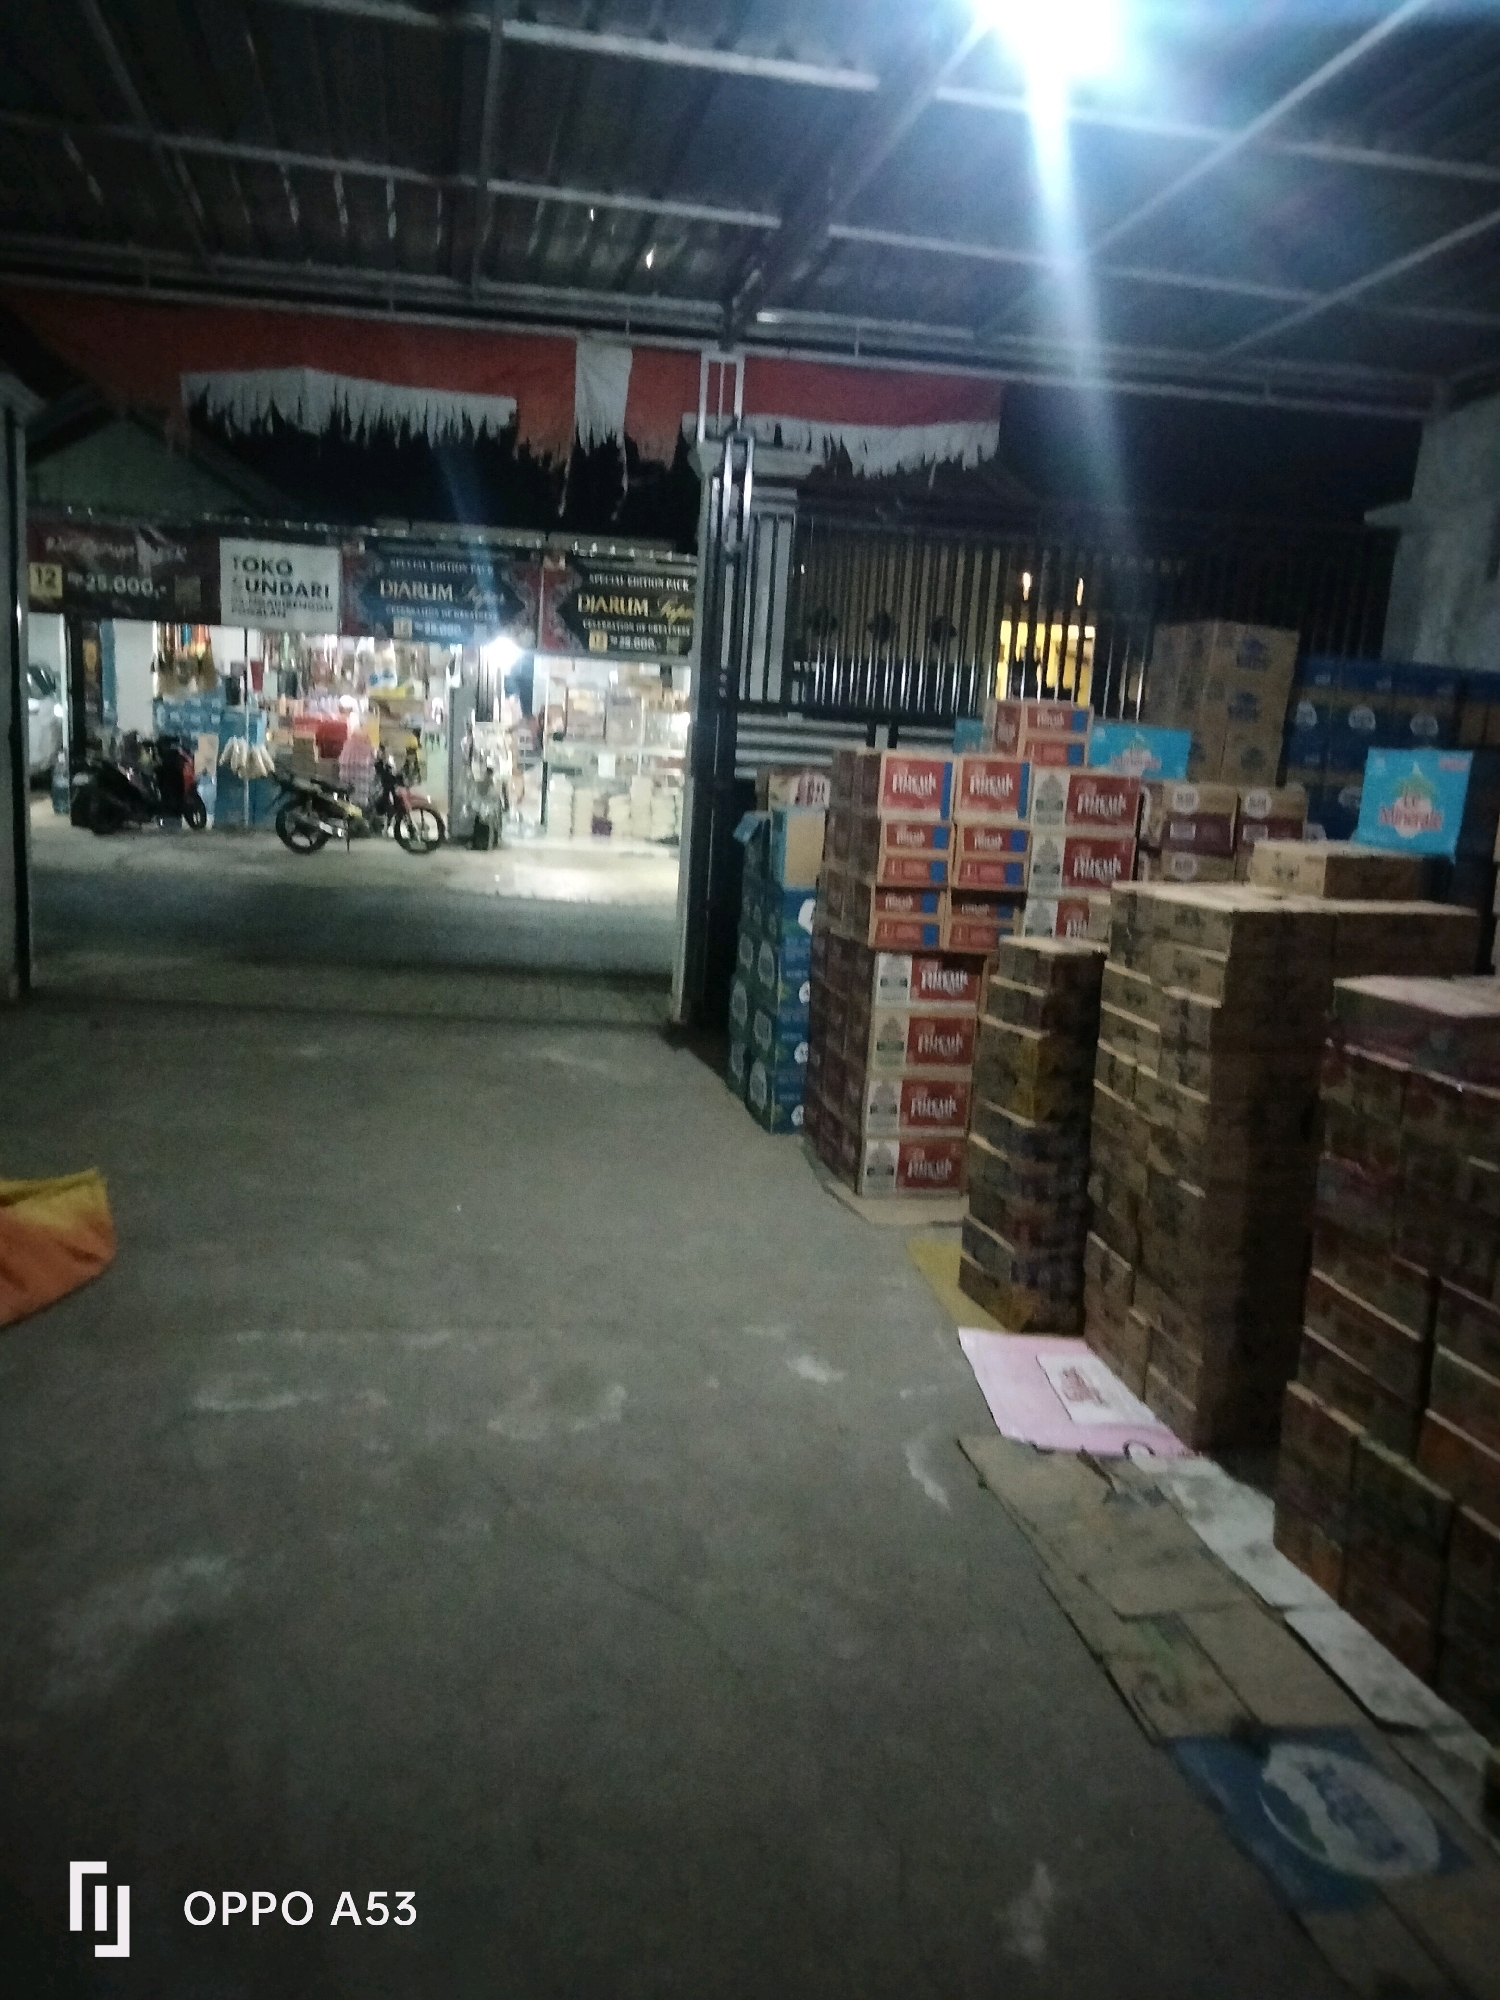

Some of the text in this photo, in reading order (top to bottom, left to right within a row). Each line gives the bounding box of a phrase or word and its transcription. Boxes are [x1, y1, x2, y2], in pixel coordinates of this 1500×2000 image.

[35, 564, 57, 590] 12
[231, 554, 293, 577] TOKO
[379, 578, 454, 602] DJARUM
[577, 593, 649, 618] DJARUM
